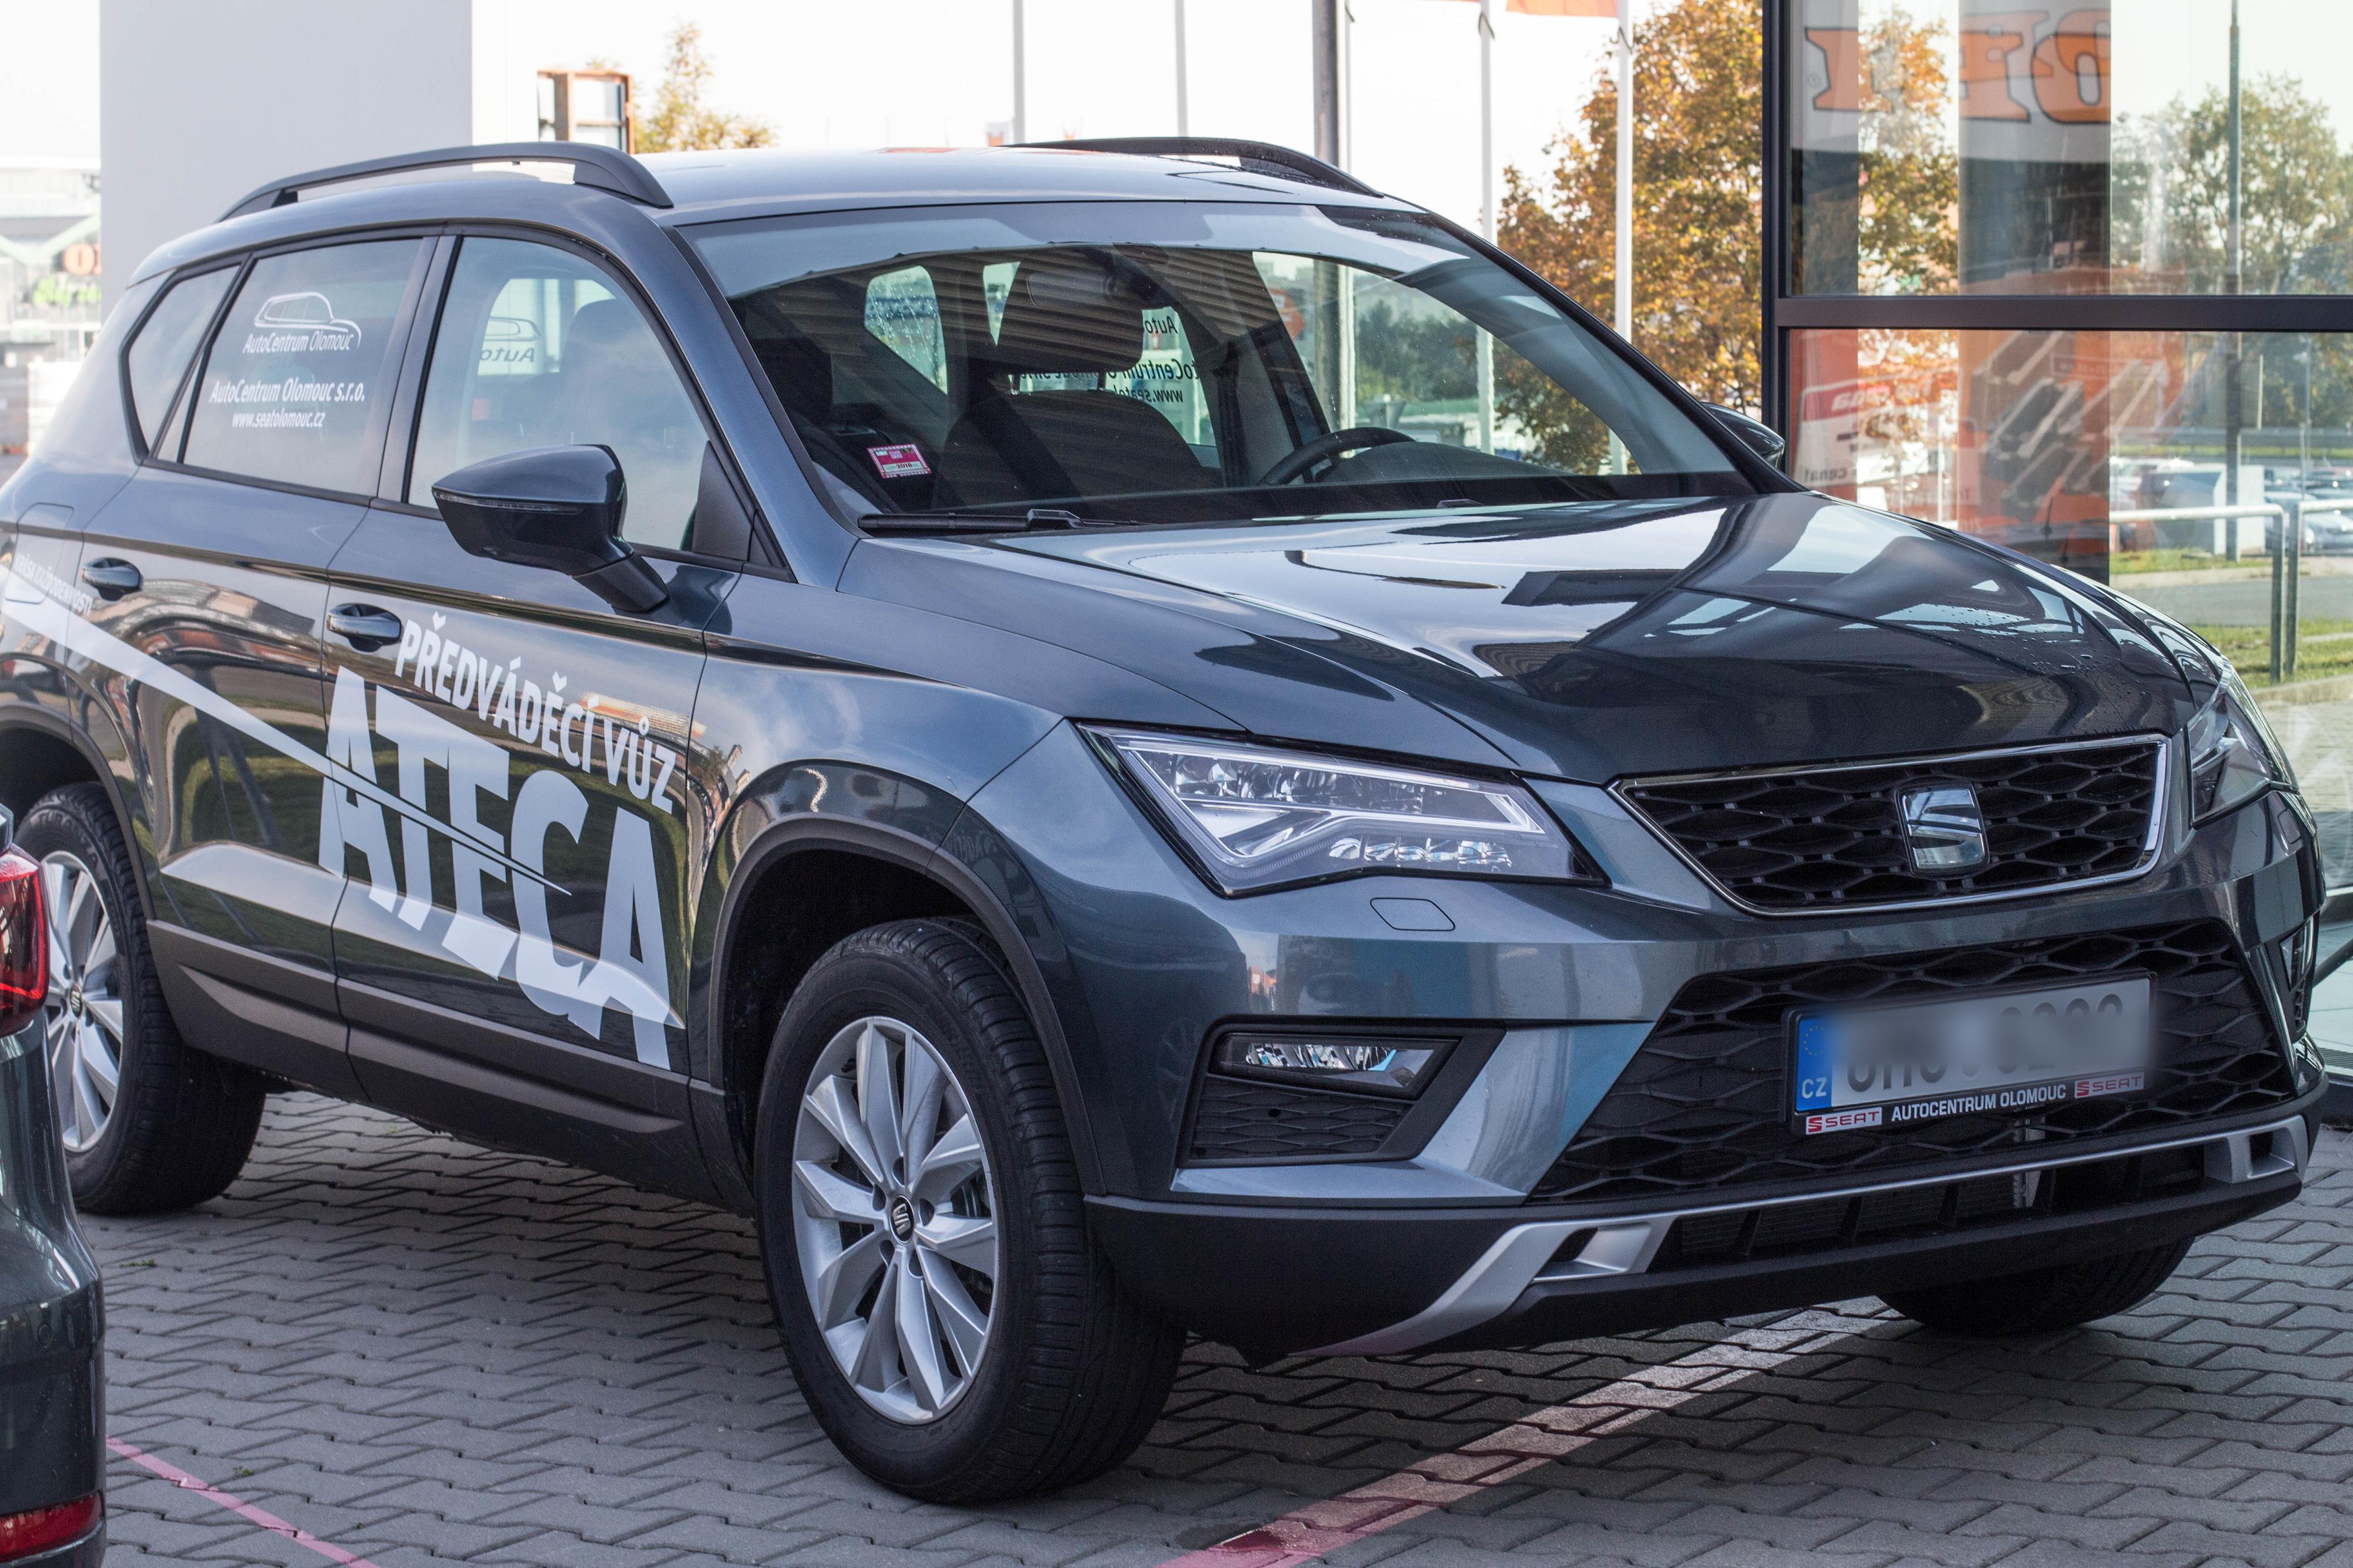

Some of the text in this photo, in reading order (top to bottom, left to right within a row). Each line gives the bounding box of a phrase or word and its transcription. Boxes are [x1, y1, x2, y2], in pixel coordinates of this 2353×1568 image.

[242, 330, 354, 353] AutoCentrum Olomouc
[209, 376, 365, 403] AutoCentrum Olomouc s.r.o.
[232, 407, 326, 428] www.seatolomouc.cz
[395, 611, 677, 815] PŘEDVÁDĚCÍ VŮZ
[318, 665, 676, 1071] ATECA
[1801, 1077, 1828, 1099] CZ
[1825, 1076, 2142, 1128] SEAT AUTOCENTRUM OLOMOUC SEAT
